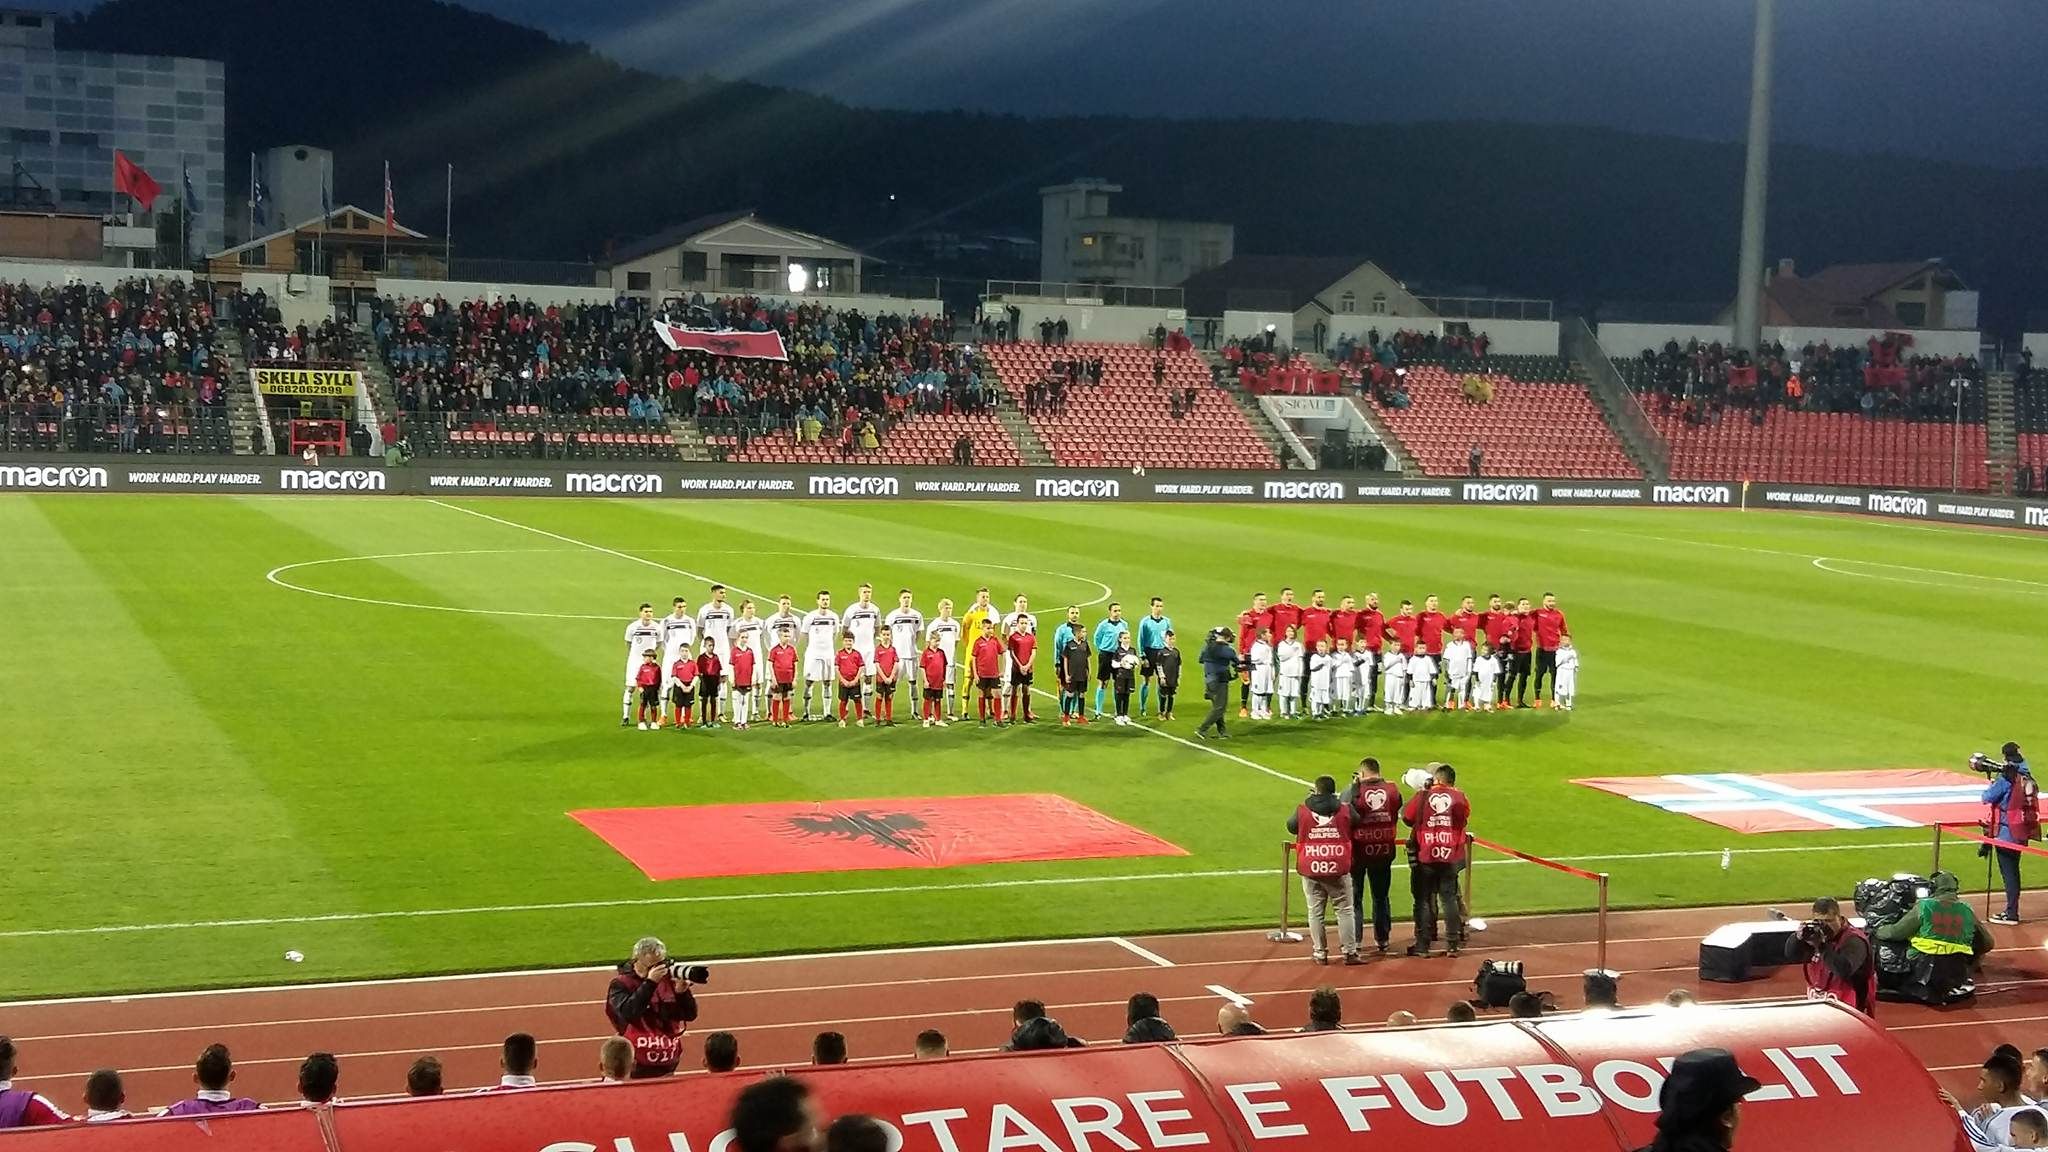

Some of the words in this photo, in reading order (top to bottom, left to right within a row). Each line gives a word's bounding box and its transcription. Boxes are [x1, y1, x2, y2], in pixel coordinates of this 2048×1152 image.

[258, 371, 309, 385] SKELA
[313, 373, 354, 386] SYLA
[270, 385, 342, 394] 0682062999
[0, 466, 107, 487] macron
[129, 472, 160, 482] WORK
[280, 469, 385, 490] macron
[430, 476, 459, 486] WORK
[566, 473, 662, 492] macron
[681, 479, 708, 489] WORK
[808, 476, 898, 495] macron
[915, 482, 940, 491] WORK
[1035, 479, 1119, 497] macron
[1155, 484, 1179, 493] WORK
[1264, 482, 1344, 499] macron
[1358, 487, 1381, 495] WORK
[1463, 483, 1539, 501] macron
[1552, 488, 1573, 498] WORK
[1653, 485, 1729, 503] macron
[1766, 492, 1791, 501] WORK
[1868, 493, 1927, 515] macron
[1304, 844, 1345, 857] PHOTO
[1311, 861, 1338, 873] 082
[1225, 1081, 1309, 1139] E
[1319, 1043, 1861, 1133] FUTBOLIT
